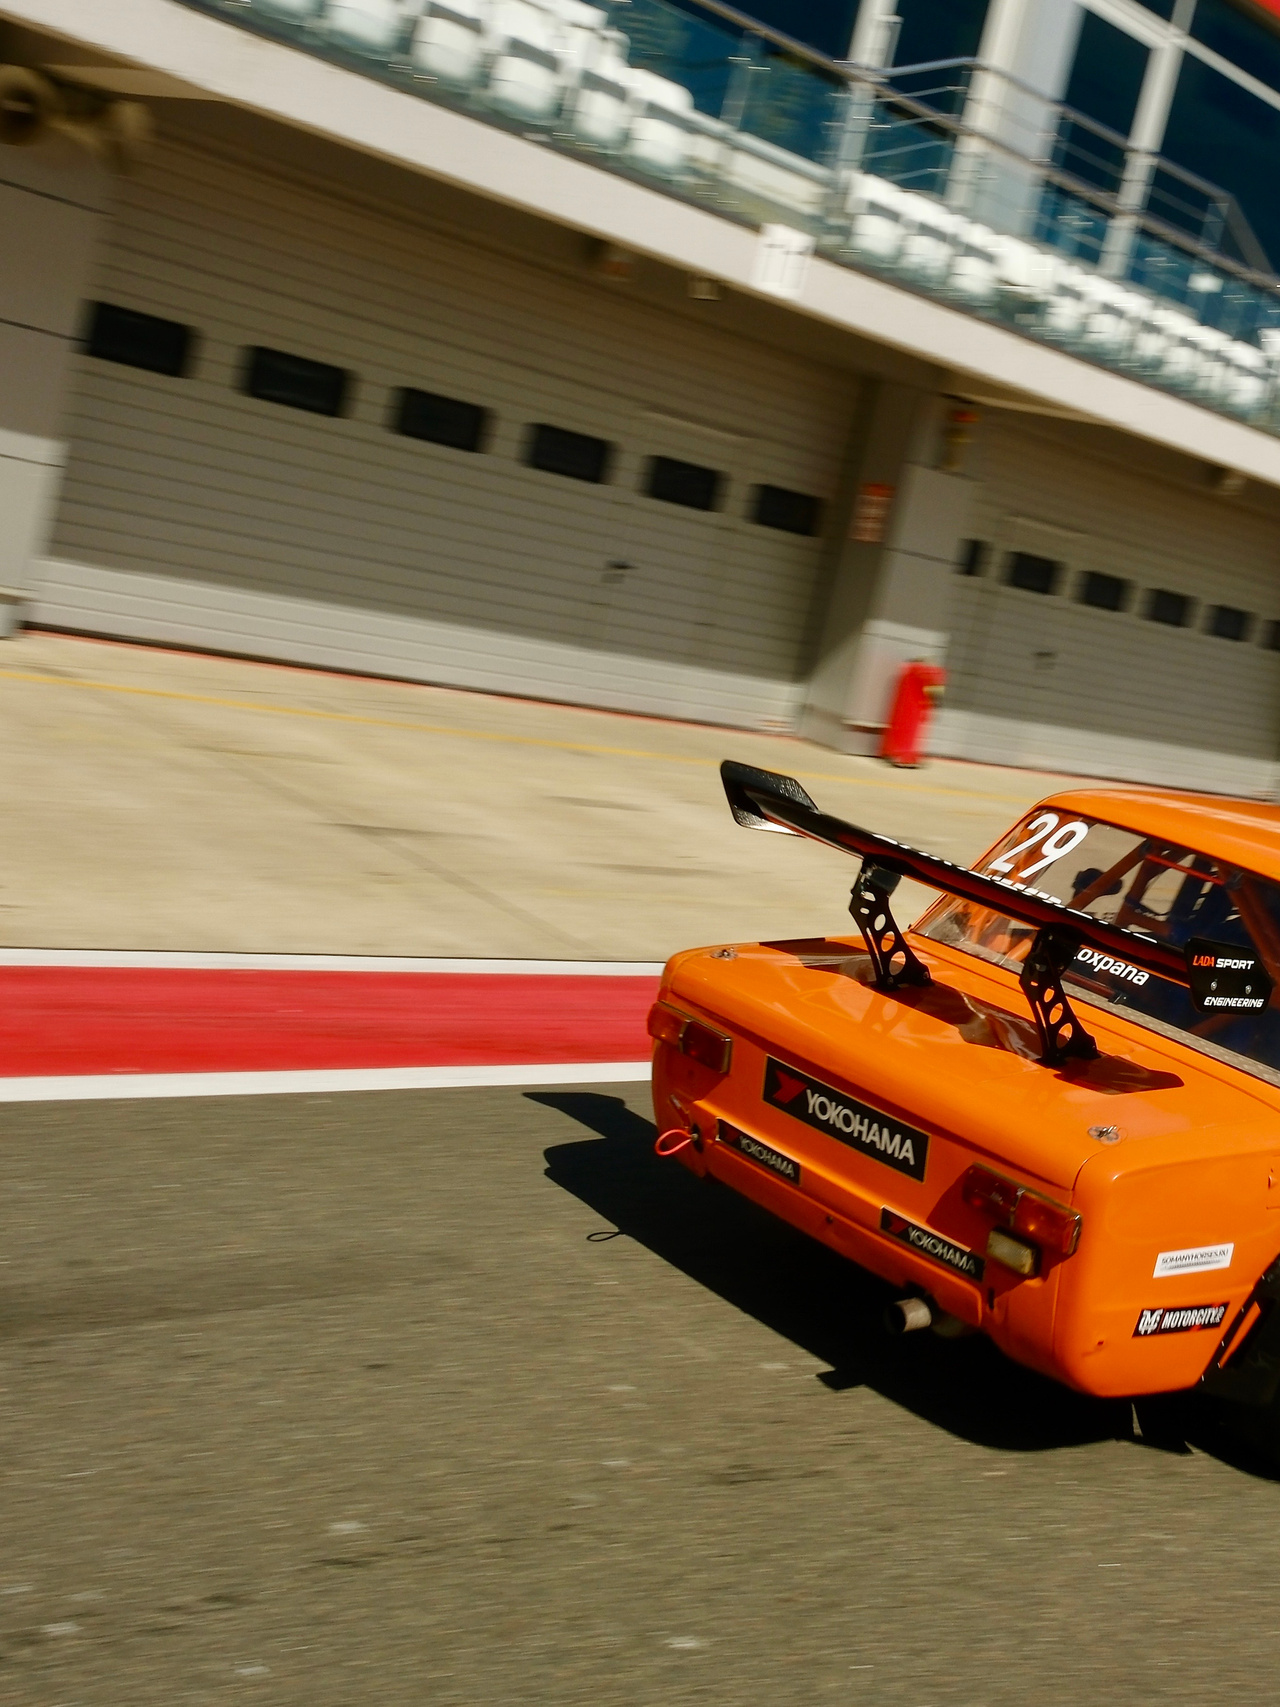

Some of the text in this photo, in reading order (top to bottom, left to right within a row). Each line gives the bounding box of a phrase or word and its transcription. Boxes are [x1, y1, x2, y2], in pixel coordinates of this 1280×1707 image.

[987, 812, 1089, 879] 29
[1192, 954, 1255, 970] LADA SPORT
[1203, 995, 1265, 1008] ENGINEERING
[806, 1088, 916, 1166] YOKOHAMA
[739, 1134, 795, 1178] YOKOHAMA
[907, 1225, 976, 1275] YOKOHAMA
